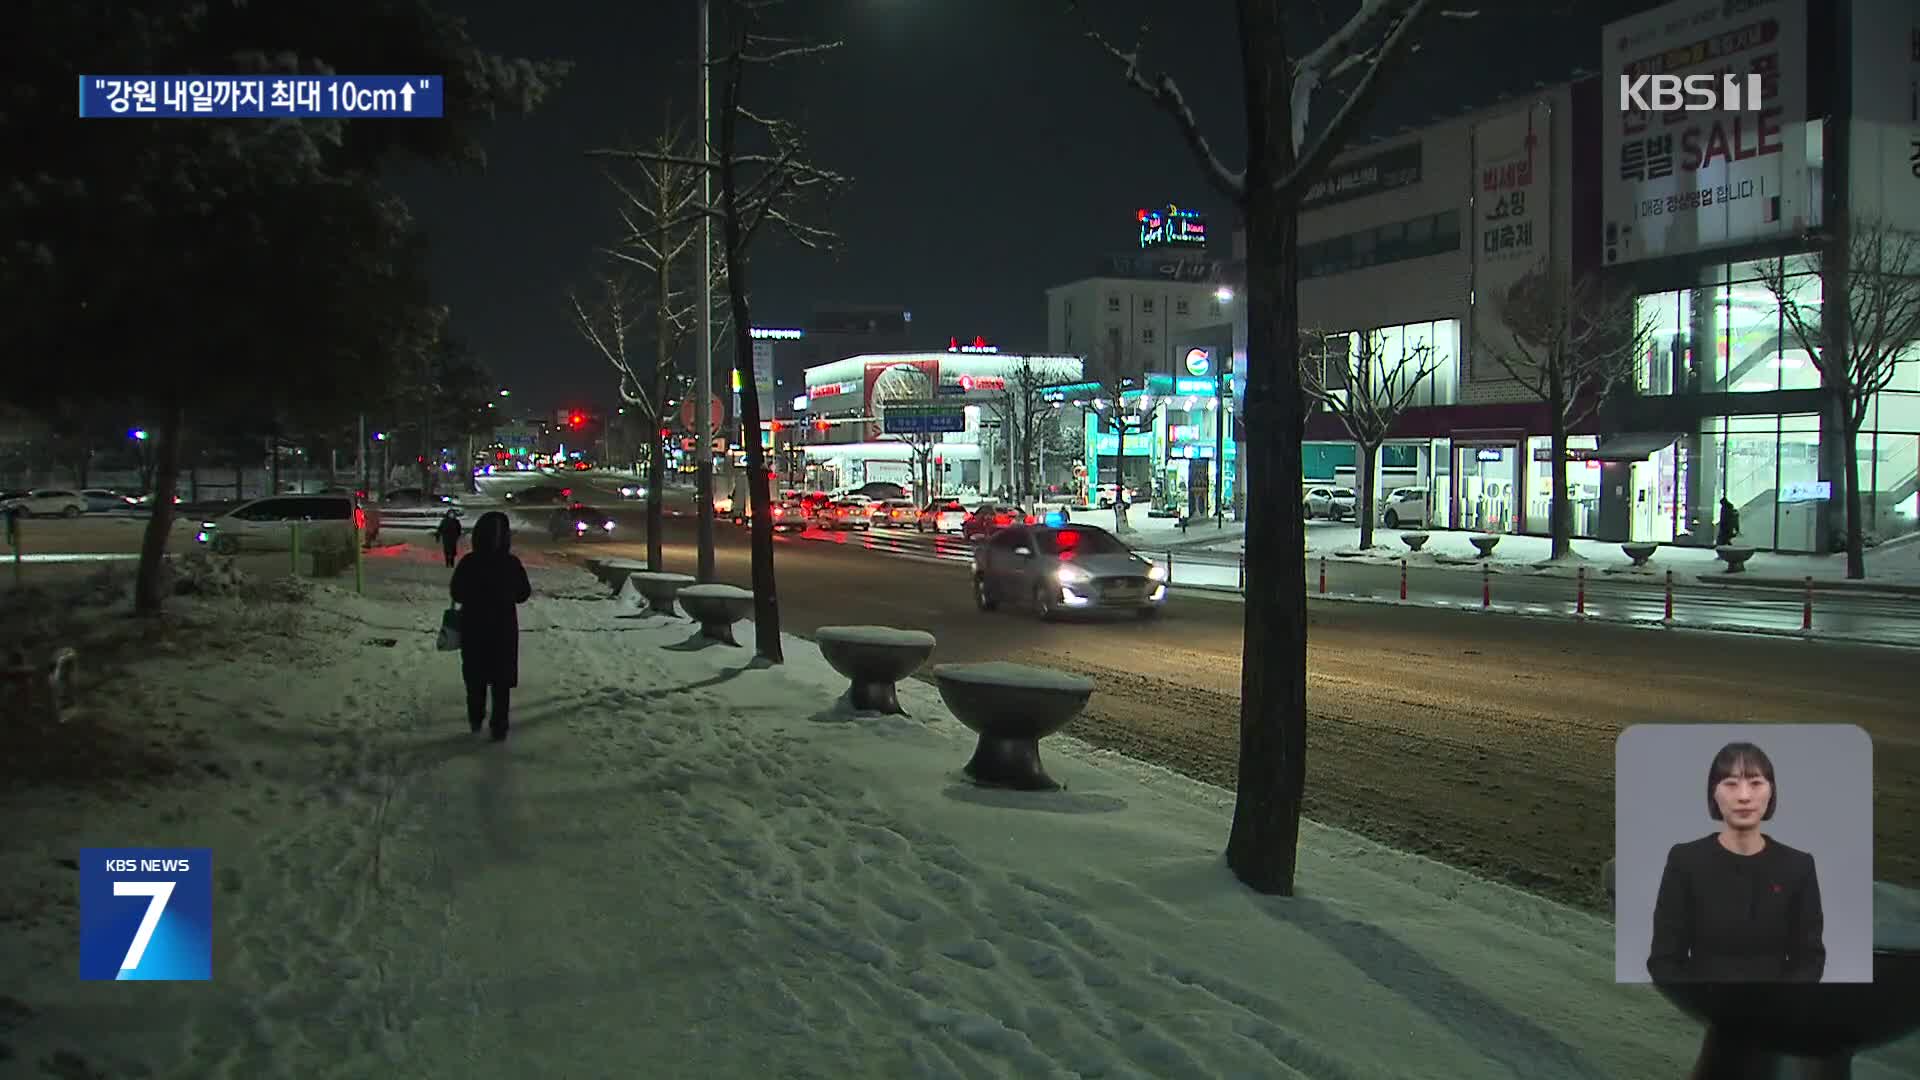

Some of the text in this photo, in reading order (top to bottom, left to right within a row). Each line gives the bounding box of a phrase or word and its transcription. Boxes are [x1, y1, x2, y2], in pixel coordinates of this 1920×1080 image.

[1620, 106, 1783, 182] 특별 SALE
[1641, 179, 1754, 217] 매장 정상영업 합니다
[1484, 219, 1533, 253] 대축제
